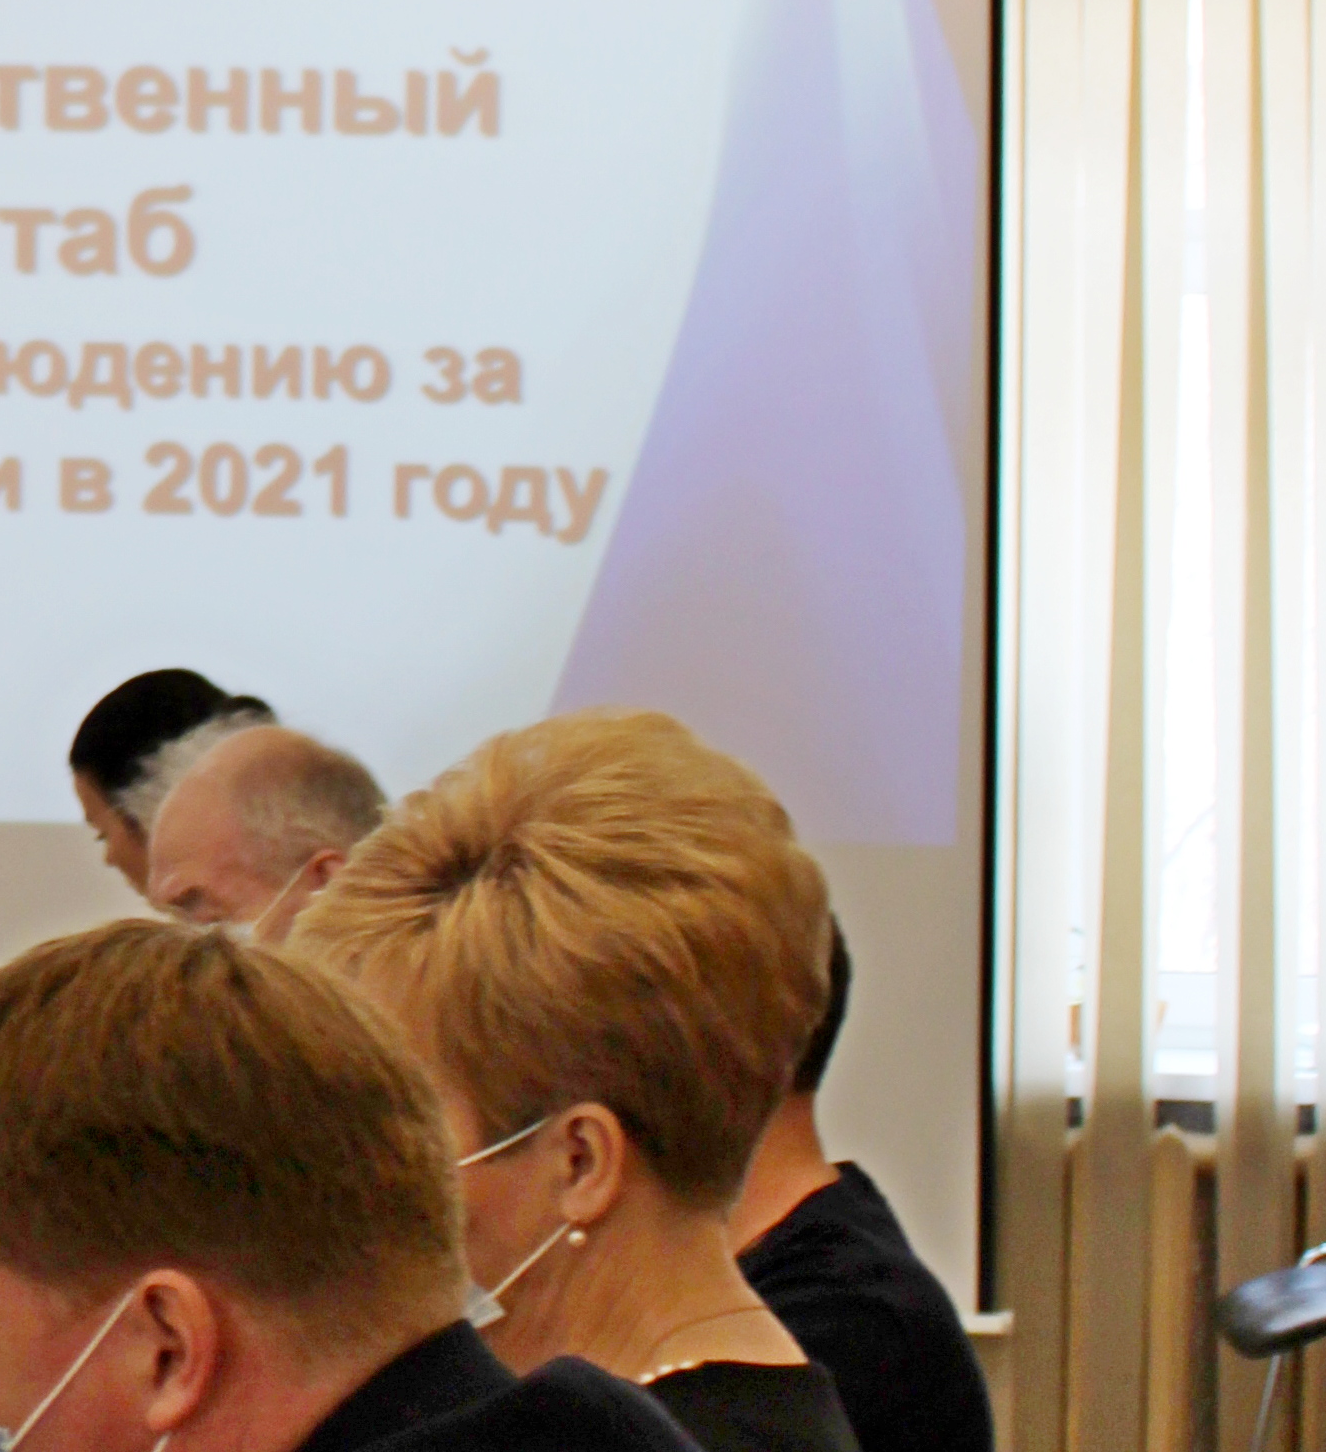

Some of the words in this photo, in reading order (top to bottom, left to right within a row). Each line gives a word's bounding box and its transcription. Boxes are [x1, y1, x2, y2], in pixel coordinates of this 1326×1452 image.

[419, 344, 523, 406] за
[59, 458, 112, 514] в
[142, 442, 352, 518] 2021
[393, 457, 610, 544] году
